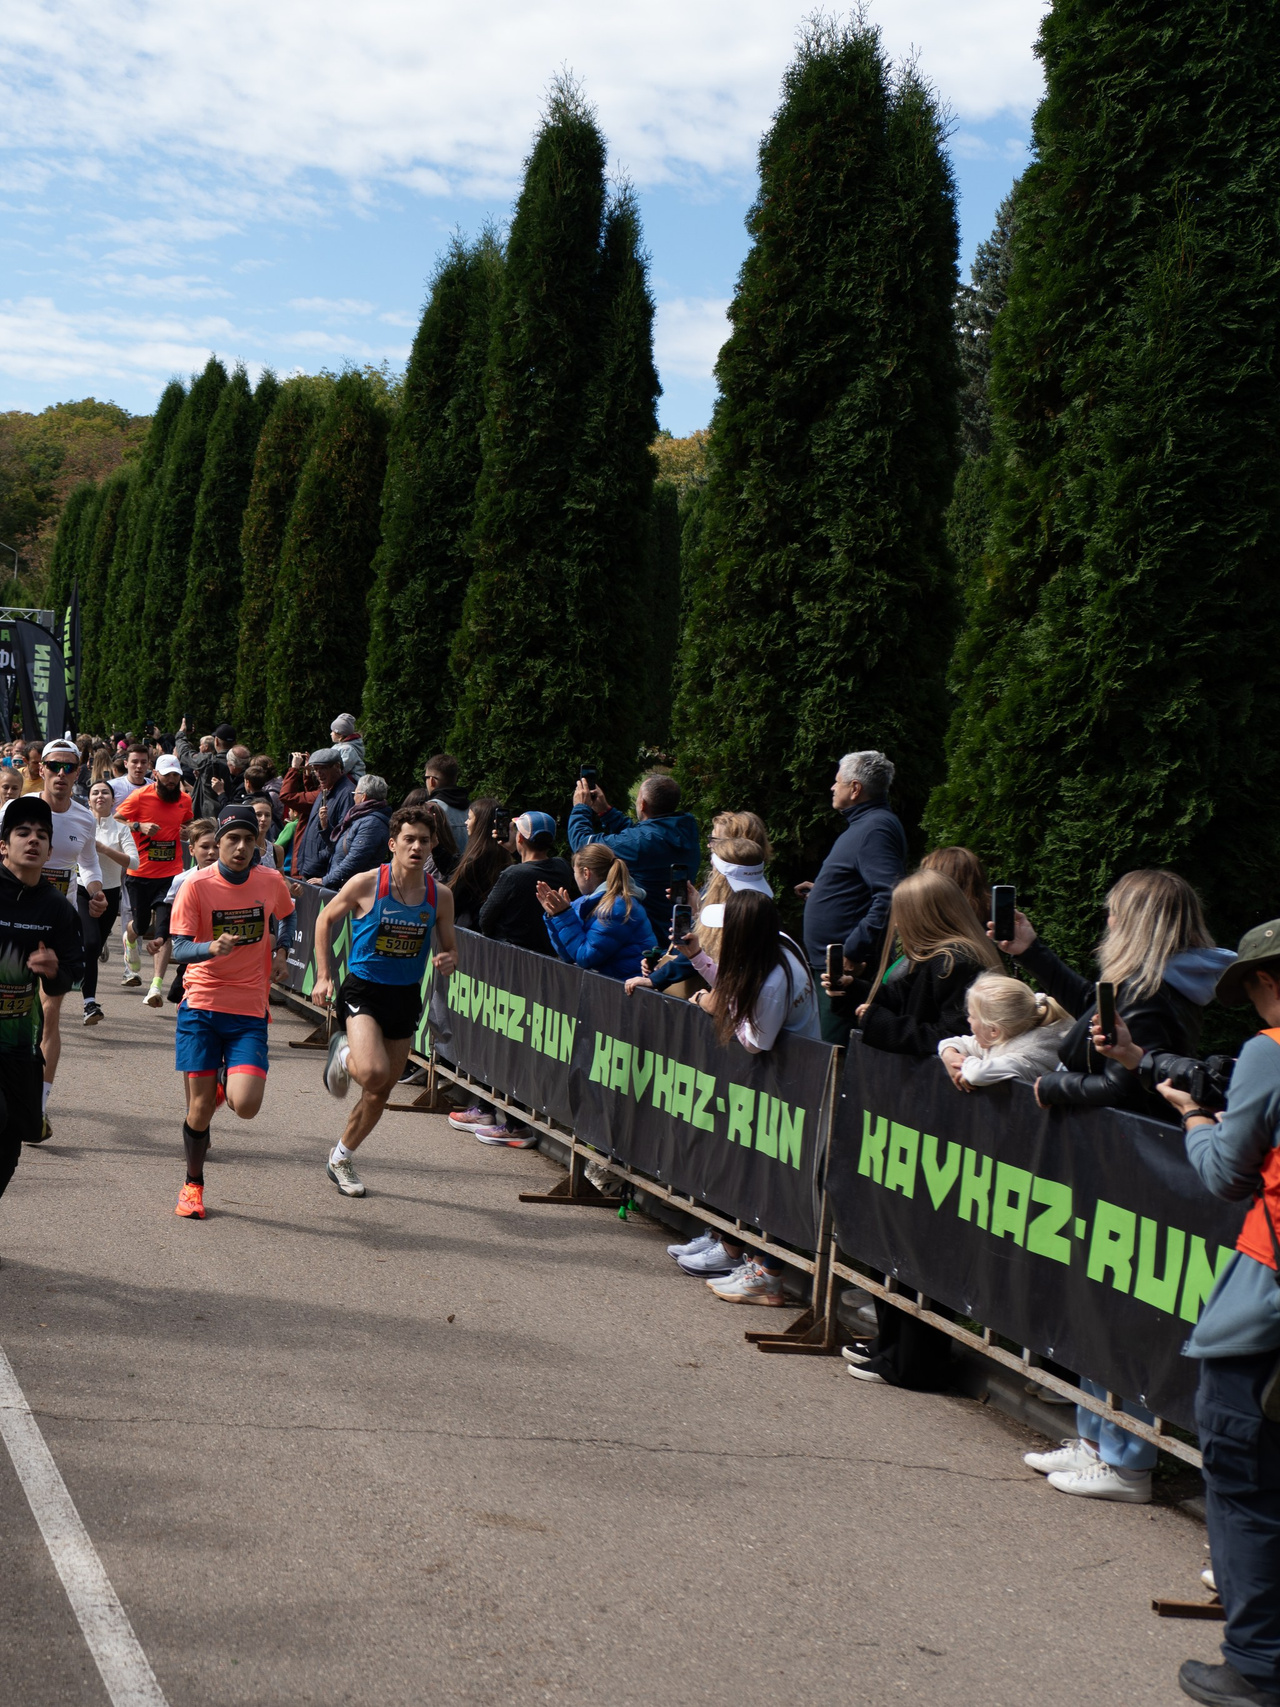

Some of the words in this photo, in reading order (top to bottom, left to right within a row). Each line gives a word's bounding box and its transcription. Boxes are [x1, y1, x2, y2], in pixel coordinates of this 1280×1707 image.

[13, 922, 52, 931] ЗОВУТ
[222, 924, 256, 936] 5217
[385, 939, 417, 951] 5200
[447, 970, 576, 1065] KAVKAZ-RUN
[588, 1030, 806, 1171] KAVKAZ-RUN
